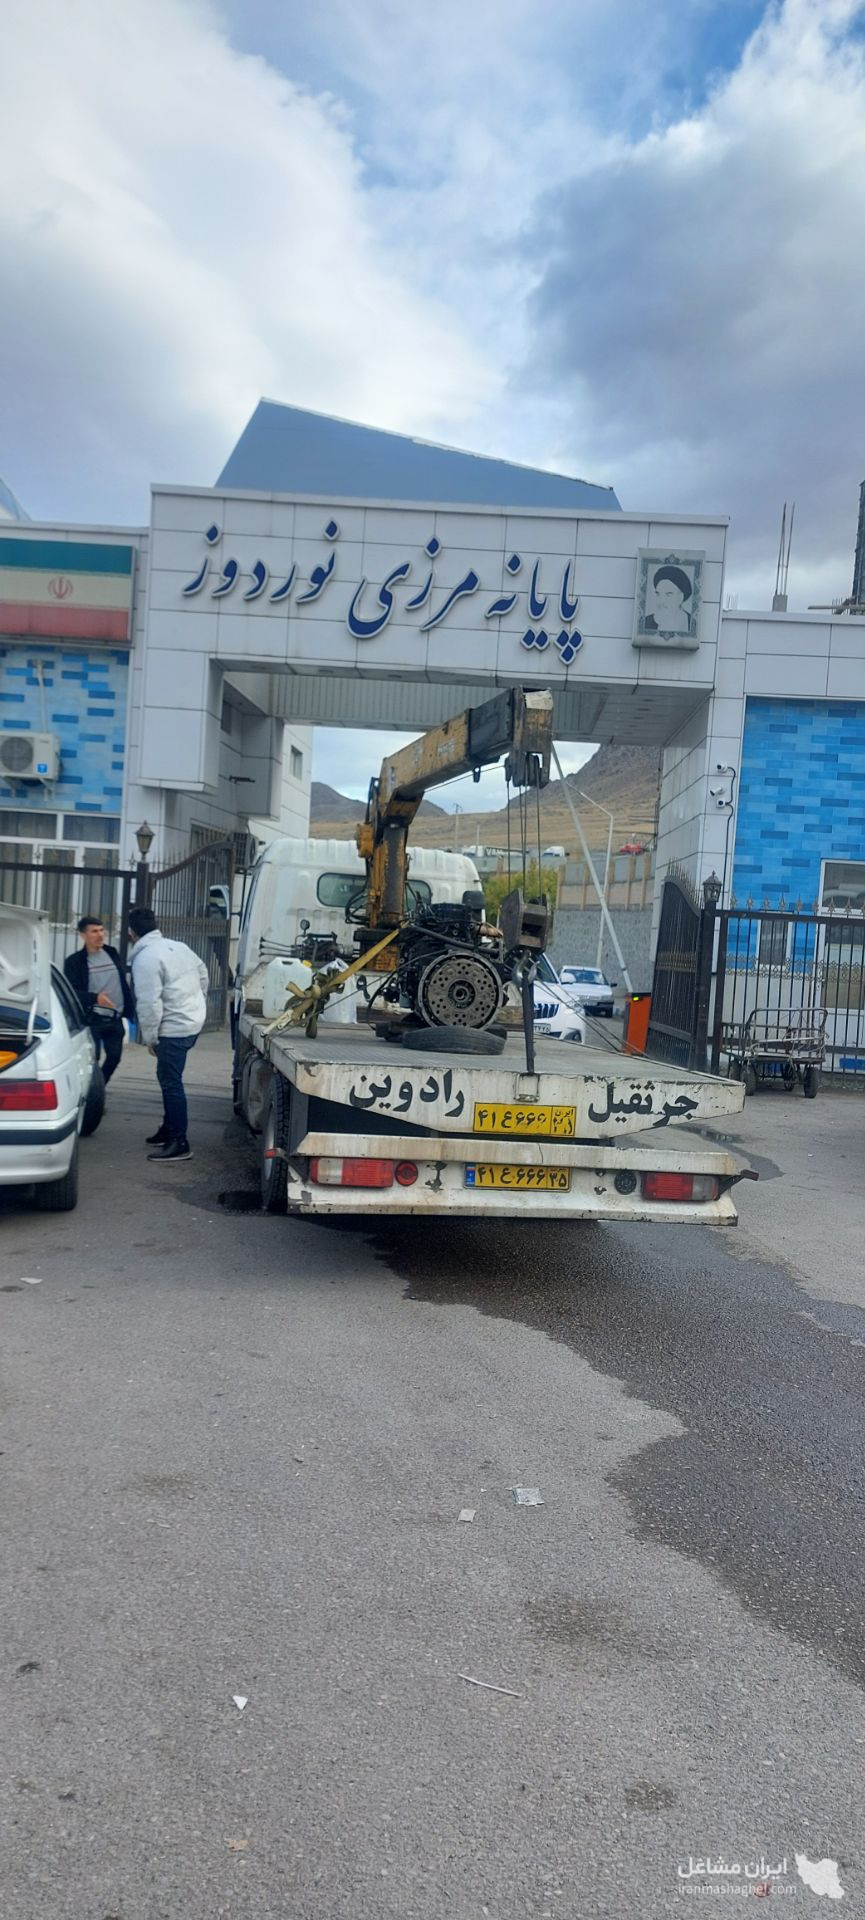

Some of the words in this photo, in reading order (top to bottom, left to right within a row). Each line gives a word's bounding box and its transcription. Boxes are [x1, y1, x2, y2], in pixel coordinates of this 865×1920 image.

[182, 517, 340, 604] نوردوز
[347, 535, 481, 638] مرزی
[485, 553, 584, 665] پایانه
[349, 1069, 465, 1118] رادوین
